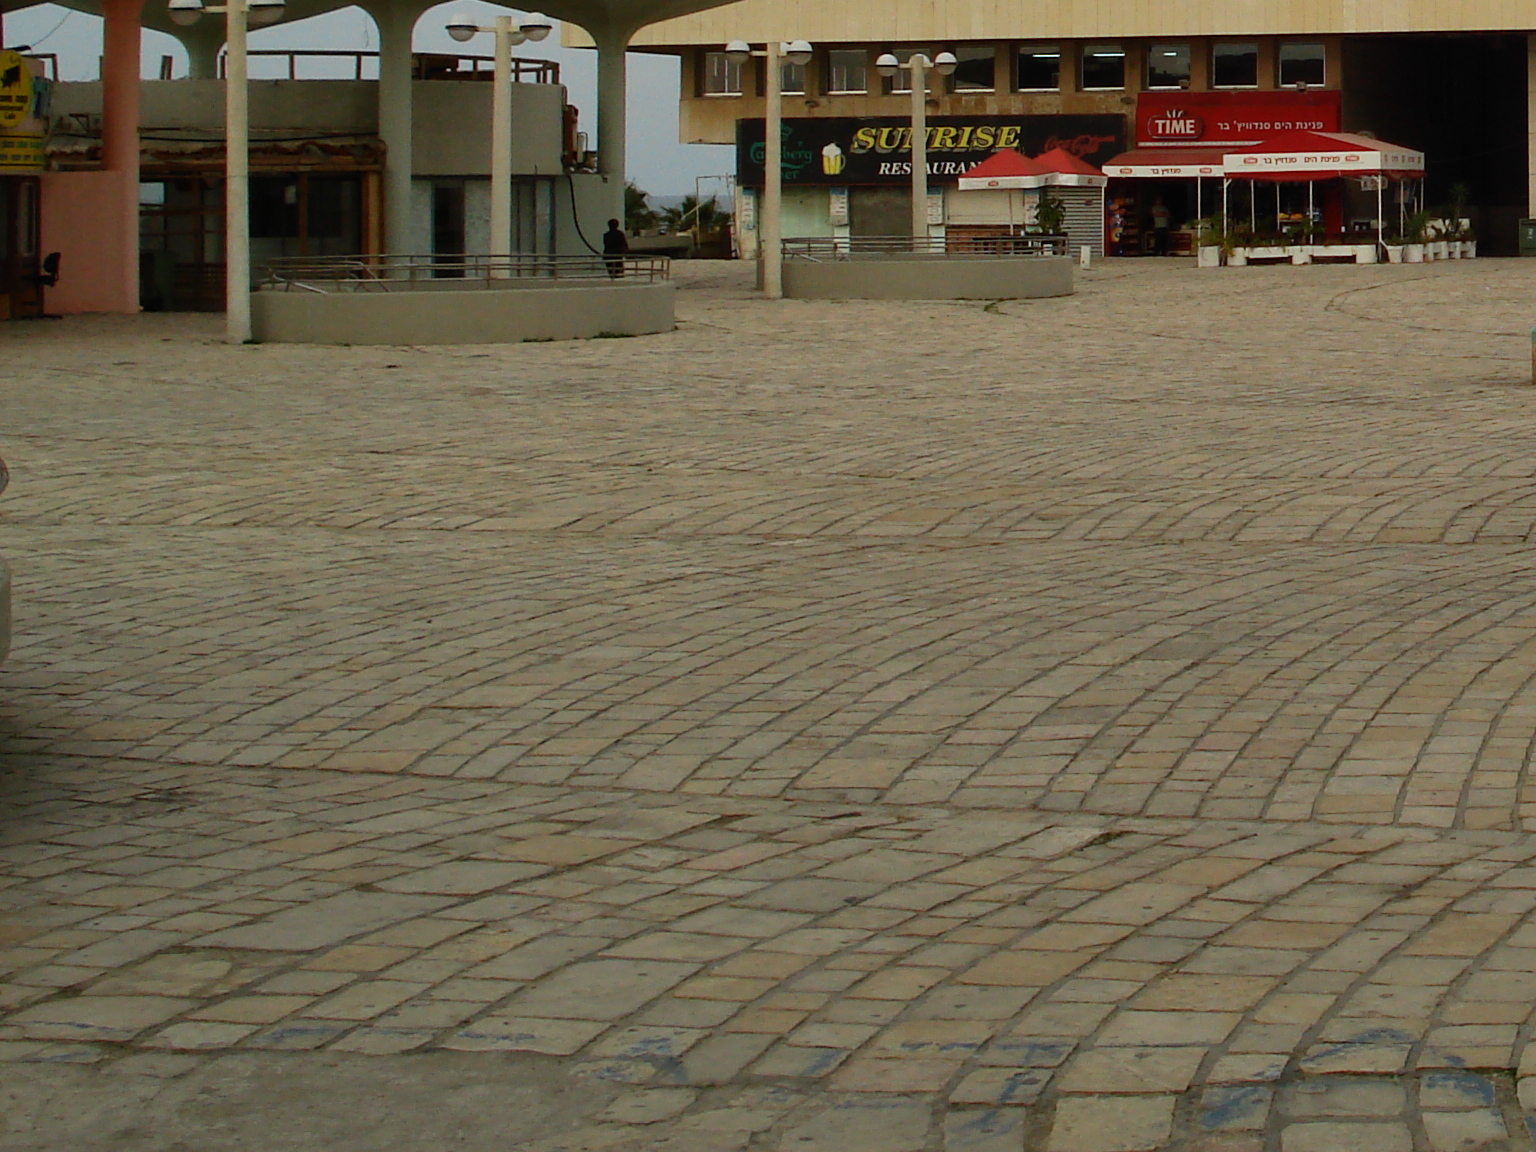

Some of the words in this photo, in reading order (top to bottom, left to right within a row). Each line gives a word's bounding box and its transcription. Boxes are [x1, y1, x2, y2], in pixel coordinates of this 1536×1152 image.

[1155, 119, 1196, 134] TIME
[1217, 121, 1230, 130] בר
[1275, 121, 1292, 130] הים
[1295, 121, 1323, 131] פנינת
[749, 141, 813, 164] Caberg
[879, 161, 982, 175] RESAURAN
